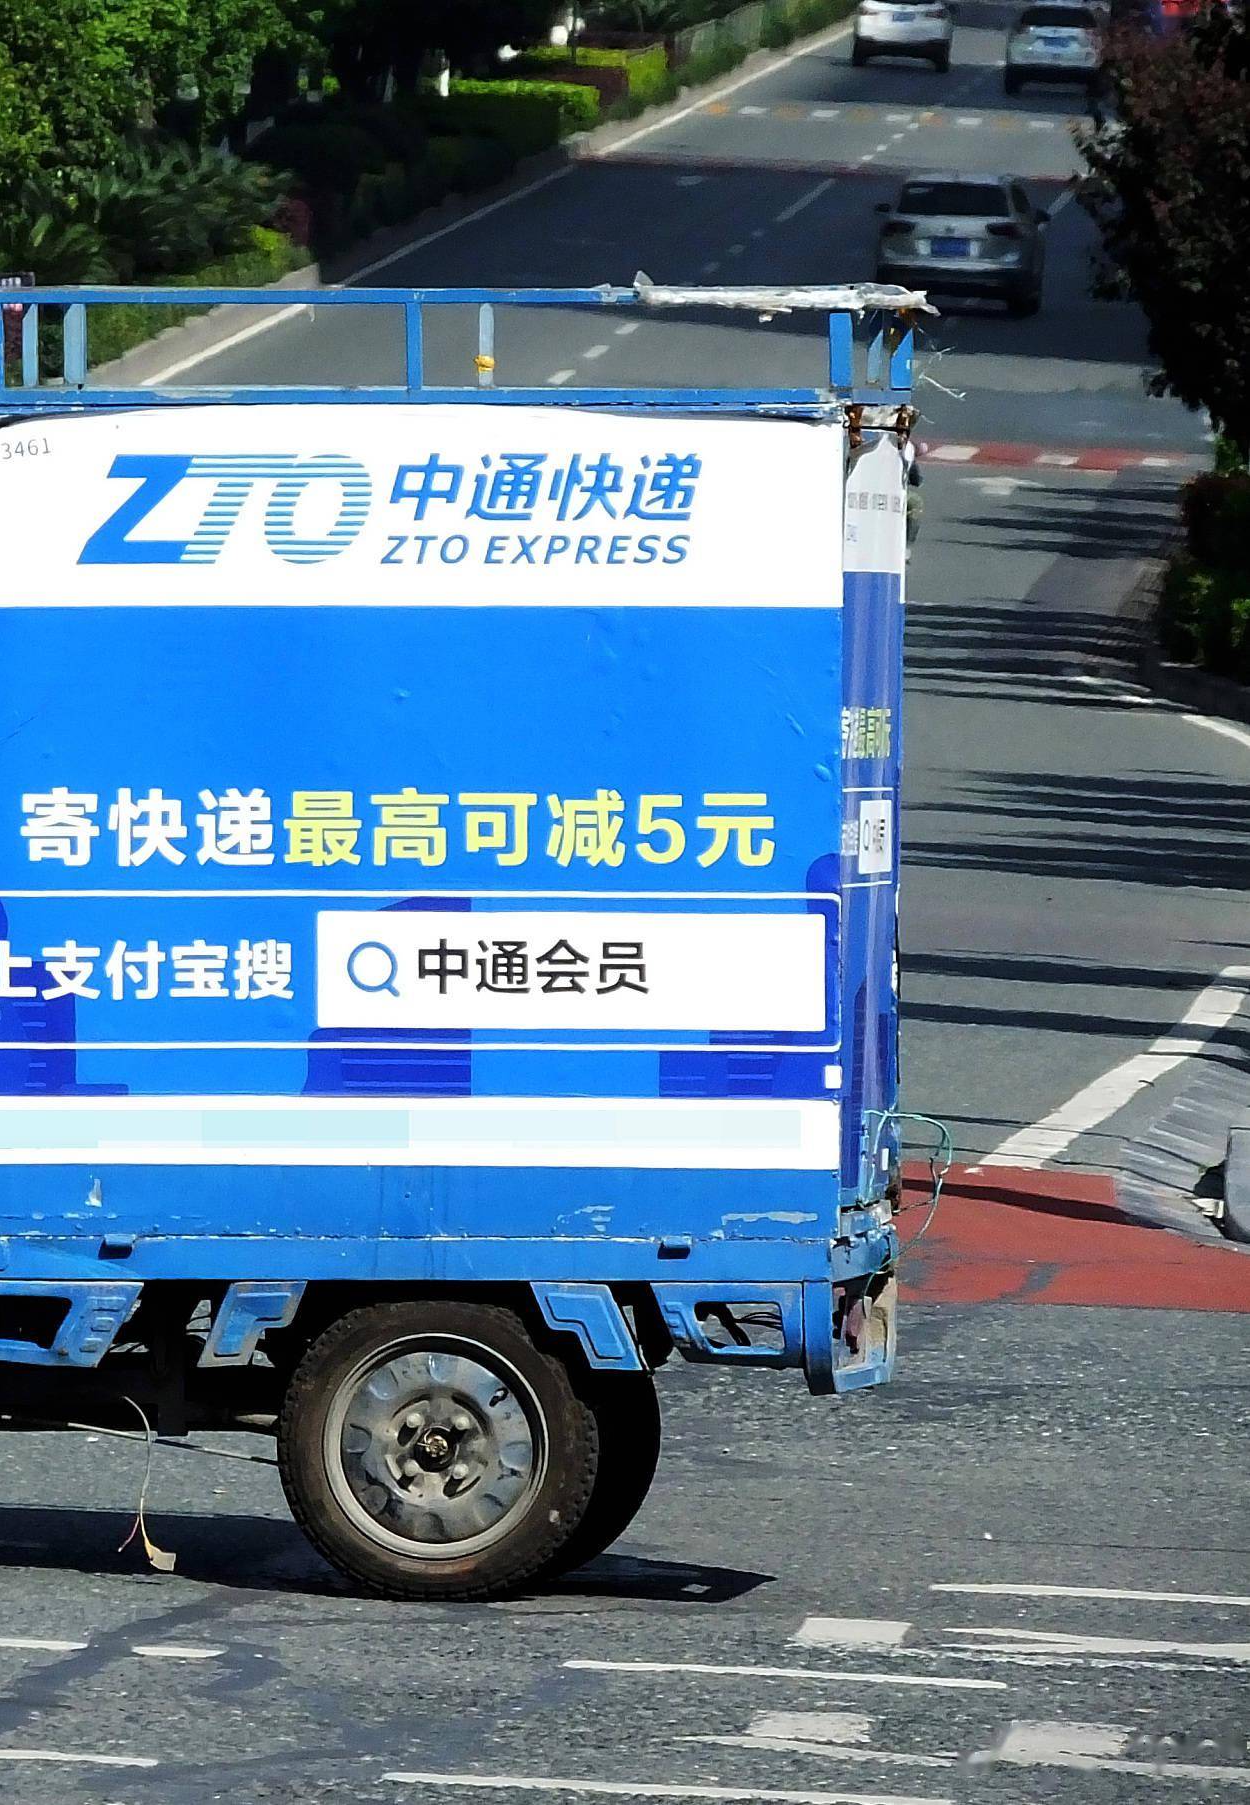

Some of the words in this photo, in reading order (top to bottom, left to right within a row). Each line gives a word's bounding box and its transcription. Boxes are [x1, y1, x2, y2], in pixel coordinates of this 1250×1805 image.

[76, 453, 373, 566] ZTO
[390, 452, 703, 522] 中通快递
[381, 534, 470, 565] ZTO
[484, 534, 691, 565] EXPRESS
[20, 786, 776, 868] 寄快递最高可减5元
[417, 938, 650, 997] 中通会员
